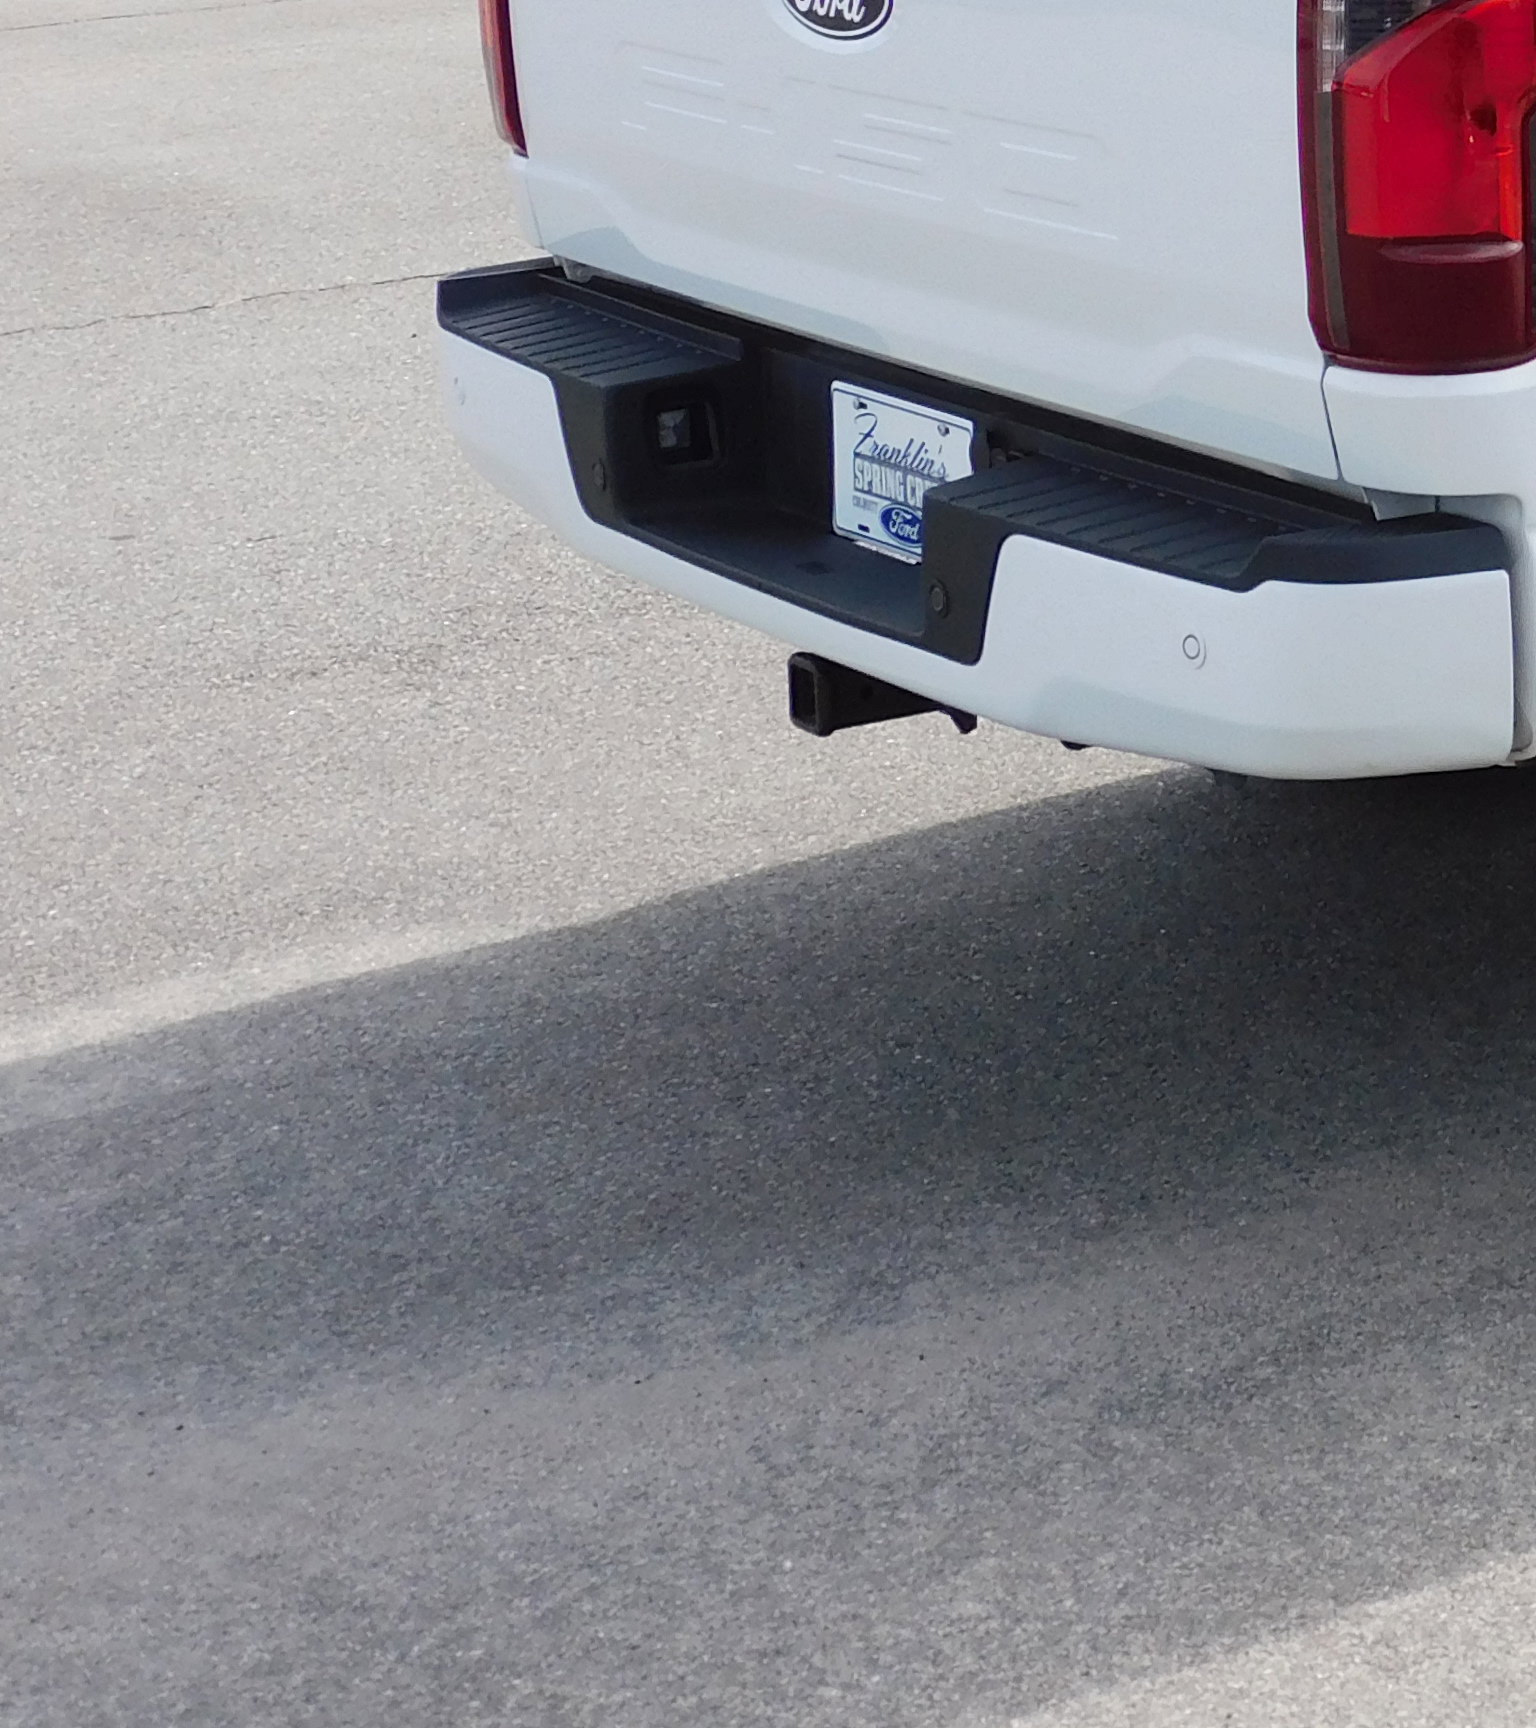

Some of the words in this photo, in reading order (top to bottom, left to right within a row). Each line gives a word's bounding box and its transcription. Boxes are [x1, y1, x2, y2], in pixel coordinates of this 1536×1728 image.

[853, 412, 950, 480] Franklin's
[855, 458, 905, 502] SPRING
[889, 509, 921, 541] Ford
